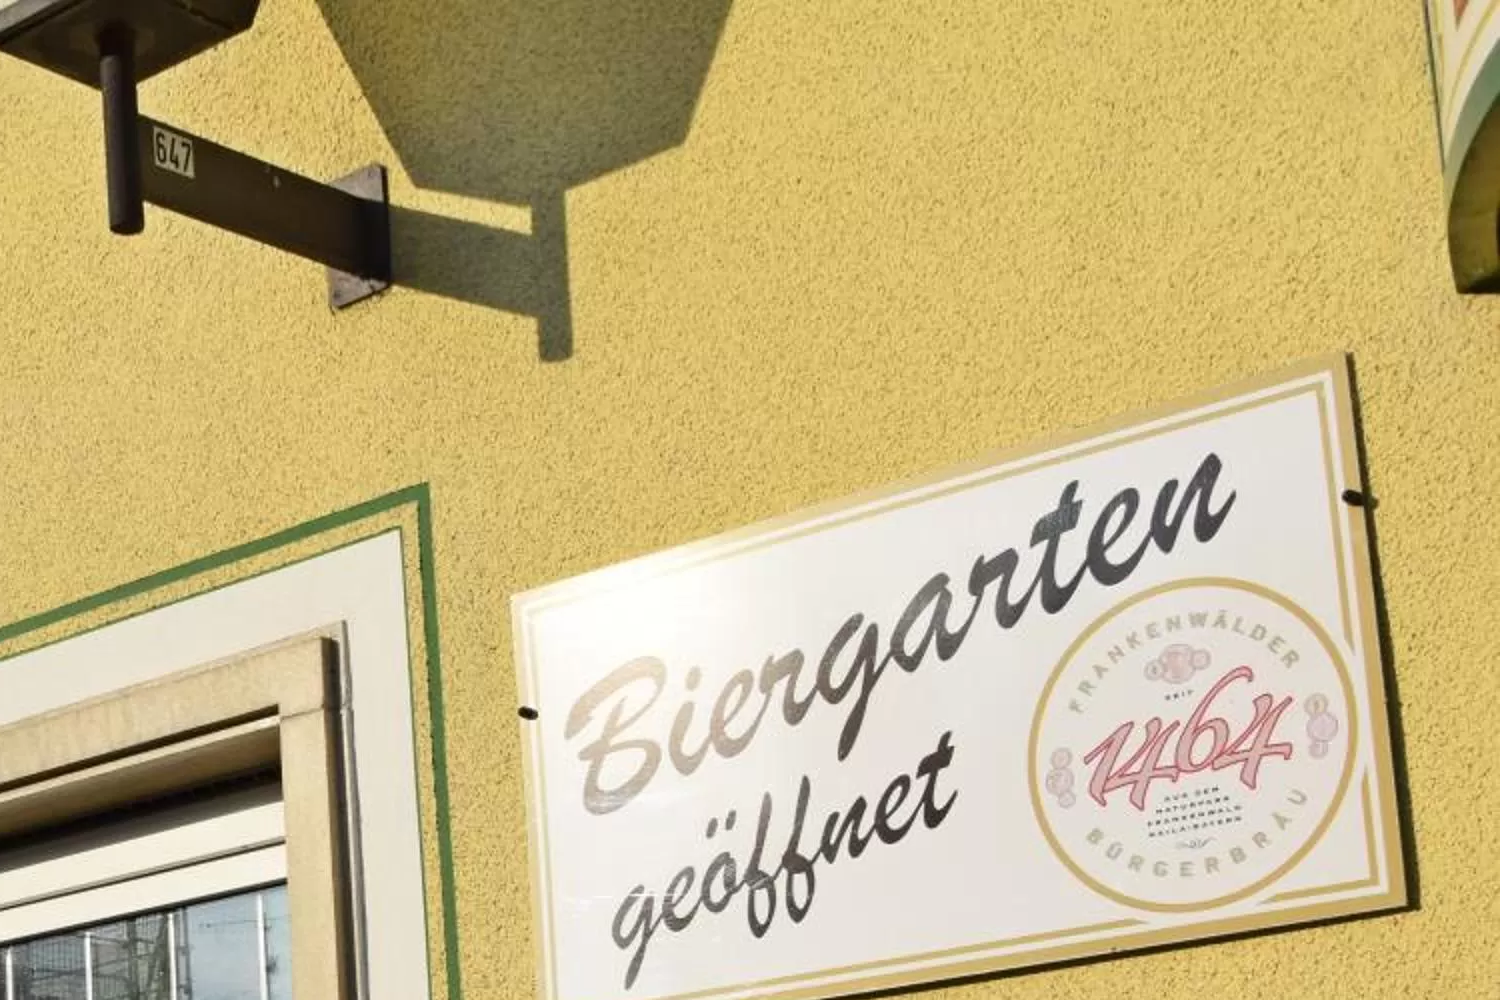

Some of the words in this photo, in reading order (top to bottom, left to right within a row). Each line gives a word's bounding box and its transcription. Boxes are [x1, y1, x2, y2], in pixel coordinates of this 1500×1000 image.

[155, 131, 191, 173] 647
[564, 453, 1236, 815] Biergarten
[1068, 610, 1300, 714] FRANKENWÄLDER
[1084, 665, 1293, 812] 1464
[611, 730, 958, 990] geöffnet
[1087, 789, 1308, 878] BÜRGERBRÄU
